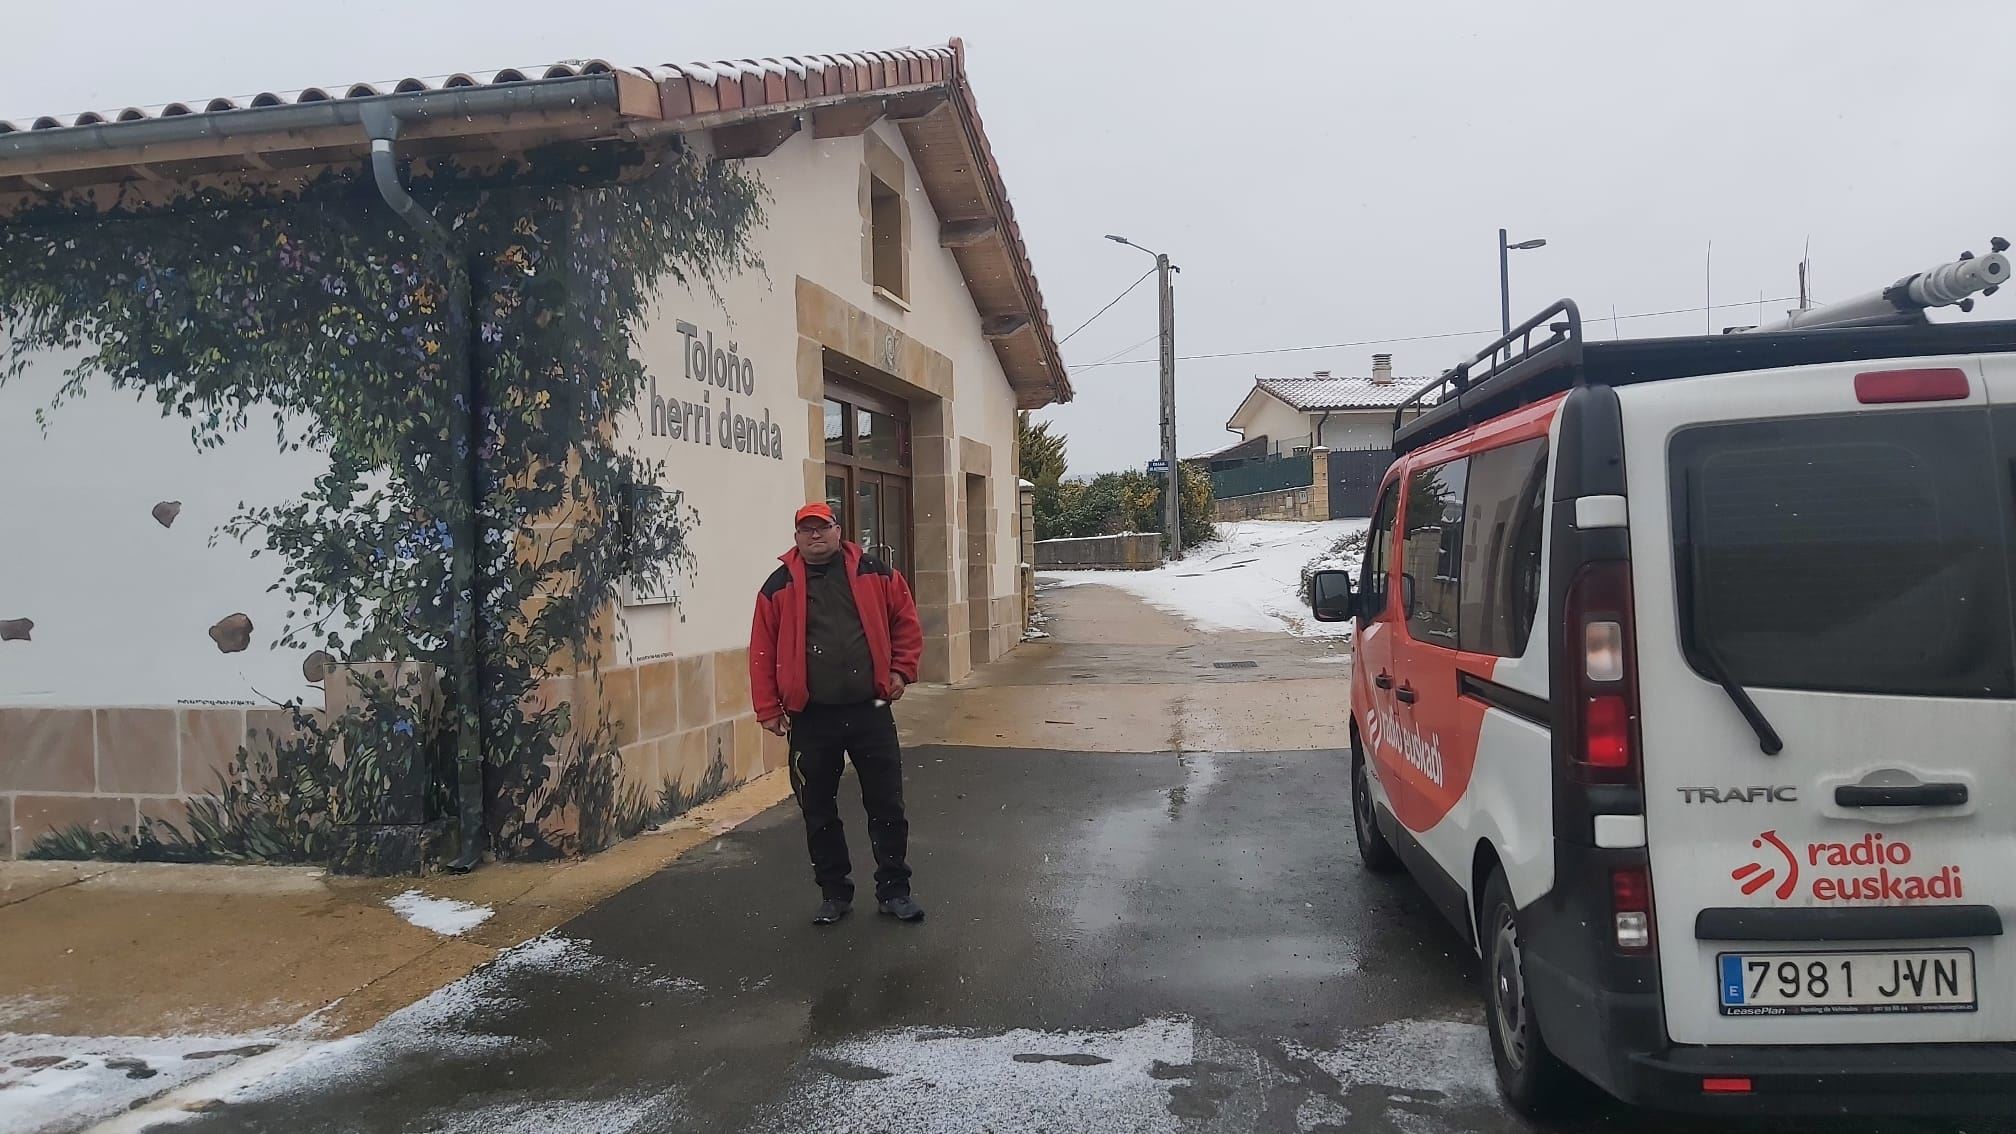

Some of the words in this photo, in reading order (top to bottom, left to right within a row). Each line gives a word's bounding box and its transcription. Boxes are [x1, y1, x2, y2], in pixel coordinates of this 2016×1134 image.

[676, 319, 754, 396] Toloño
[650, 375, 711, 445] herri
[718, 398, 783, 460] denda
[1382, 704, 1403, 754] radio
[1403, 722, 1443, 788] euskadi
[1677, 784, 1798, 803] TRAFIC
[1807, 833, 1911, 866] radio
[1812, 866, 1963, 900] euskadi
[1729, 985, 1739, 997] E
[1748, 960, 1854, 999] 7981
[1878, 958, 1959, 997] JVN
[1727, 1007, 1786, 1015] LeasePlan
